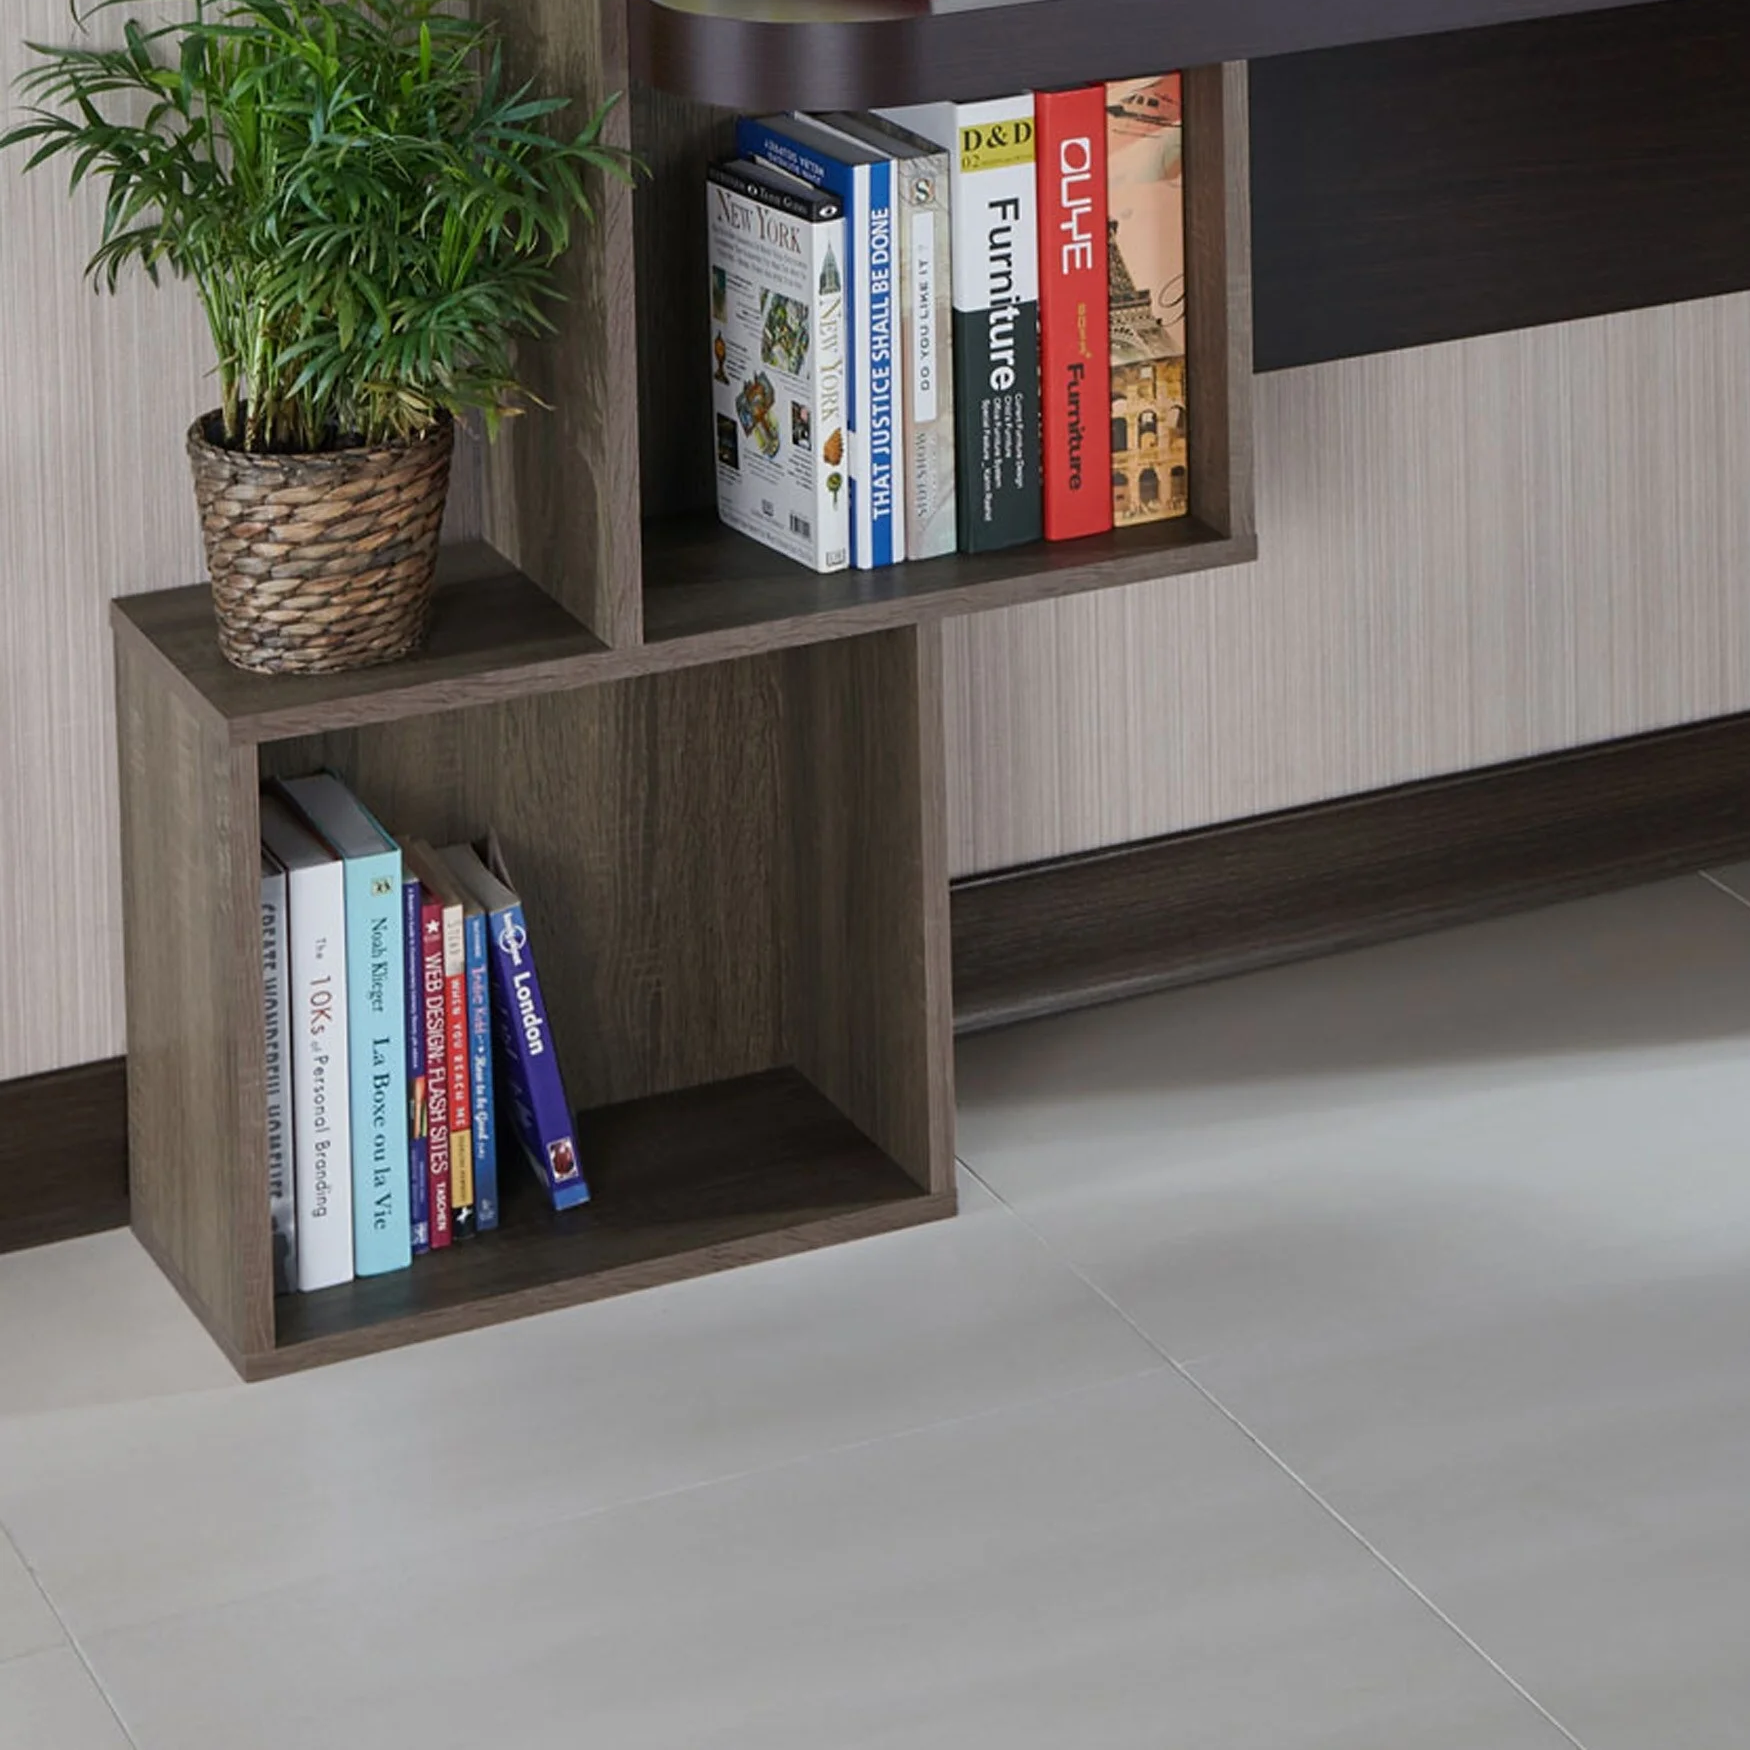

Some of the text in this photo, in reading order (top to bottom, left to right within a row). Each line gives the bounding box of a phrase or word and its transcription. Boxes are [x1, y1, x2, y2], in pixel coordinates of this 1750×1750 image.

[715, 191, 802, 255] NEW YORK
[918, 258, 928, 275] IT
[919, 281, 929, 319] LIKE
[988, 197, 1021, 391] Furniture
[820, 297, 843, 422] NEW YORK
[871, 207, 890, 519] THAT JUSTICE SHALL BE DONE
[919, 324, 929, 359] YOU
[920, 366, 930, 391] DO
[1015, 424, 1024, 458] Furniture
[1066, 363, 1085, 491] Furniture
[993, 458, 1002, 488] System
[1015, 460, 1024, 489] Design
[315, 937, 326, 960] The
[368, 917, 388, 1013] Noah Klieger
[425, 953, 444, 992] WEB
[309, 975, 333, 1035] 10Ks
[450, 978, 463, 1015] WHEN
[512, 972, 546, 1056] London
[426, 996, 446, 1065] DESIGN:
[452, 1023, 463, 1047] YOU
[313, 1055, 330, 1133] Personal
[428, 1068, 447, 1123] FLASH
[453, 1054, 465, 1101] REACH
[373, 1037, 392, 1231] La Boxe ou la Vie
[454, 1107, 466, 1127] ME
[475, 1112, 490, 1140] Good
[429, 1126, 449, 1174] SITES
[312, 1141, 331, 1218] Branding
[436, 1182, 447, 1232] TASCHEN
